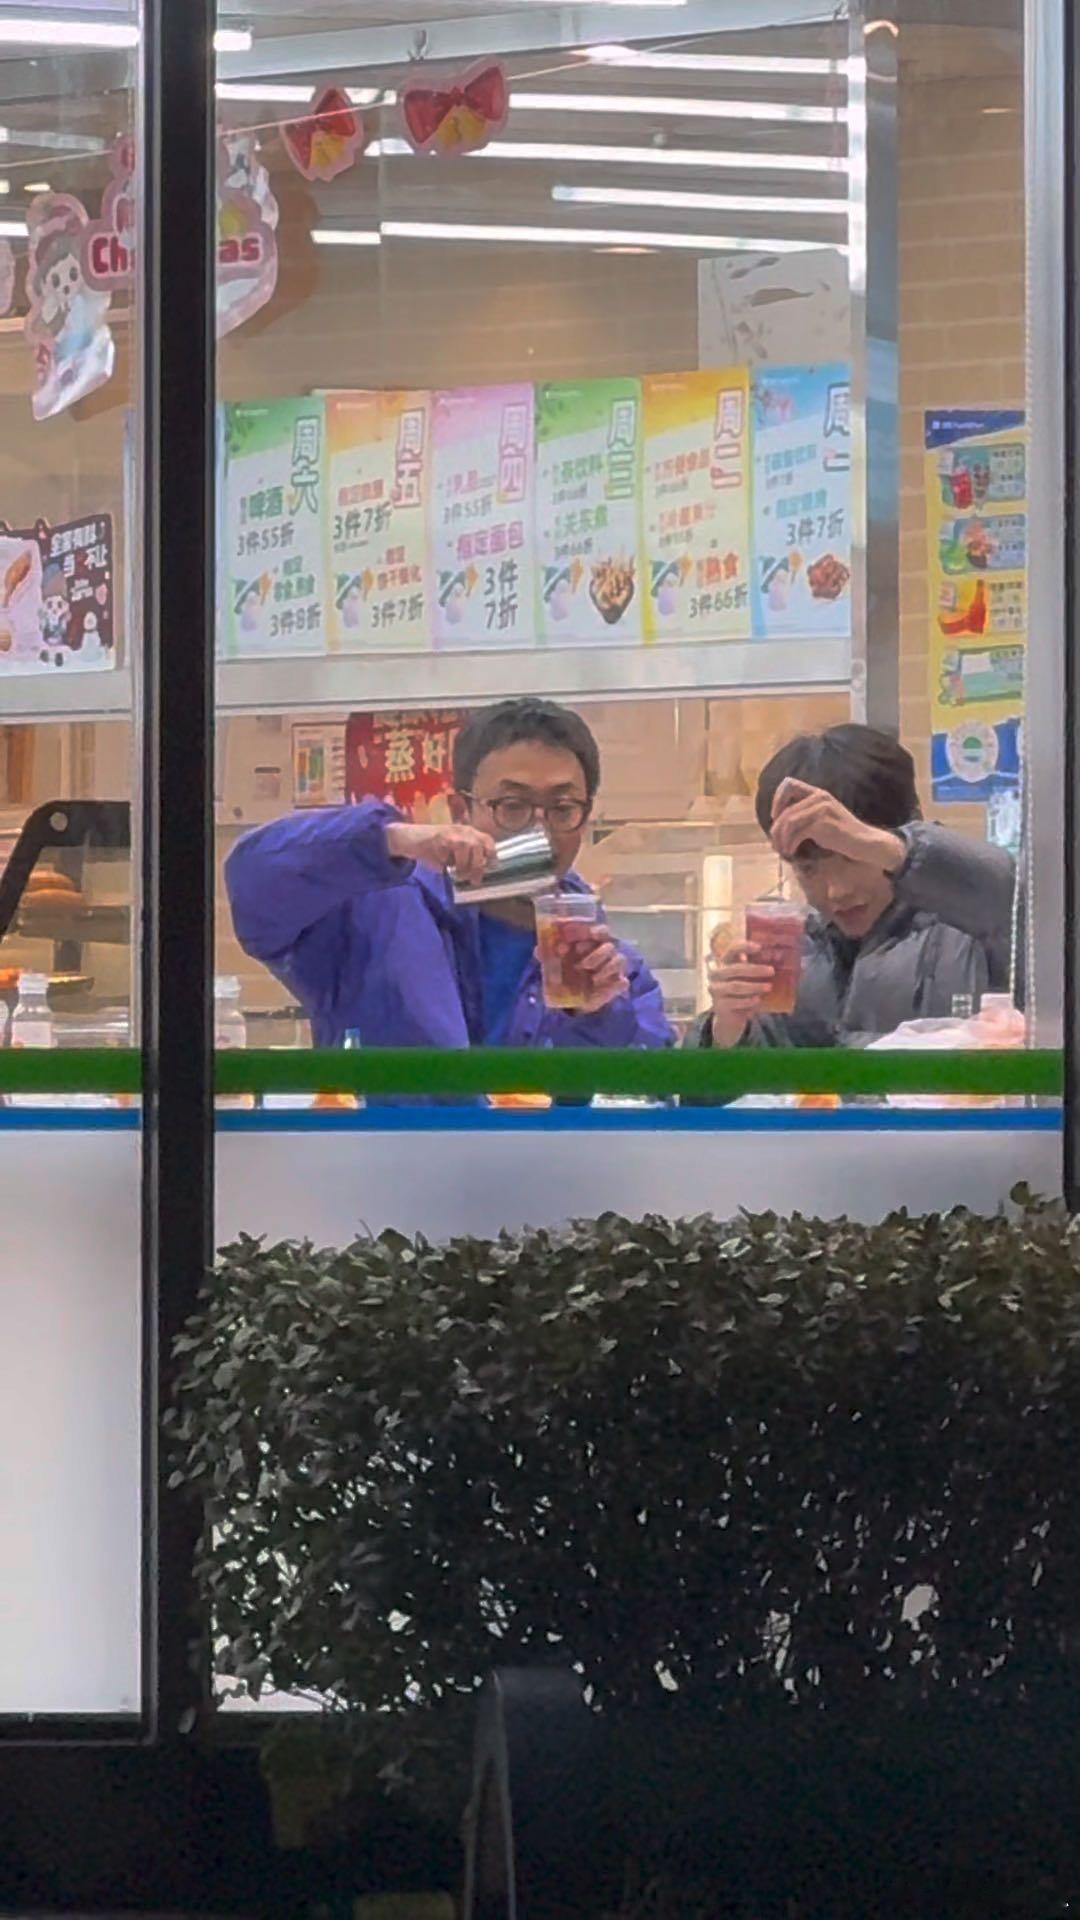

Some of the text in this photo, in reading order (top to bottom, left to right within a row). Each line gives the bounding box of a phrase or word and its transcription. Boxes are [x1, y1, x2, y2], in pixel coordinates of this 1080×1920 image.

[391, 407, 426, 509] 周五
[497, 402, 528, 503] 周四
[606, 397, 637, 502] 周三
[711, 387, 746, 490] 周二
[288, 415, 321, 516] 周六
[236, 521, 295, 557] 3件55折
[332, 502, 393, 541] 3件7折
[785, 508, 845, 546] 3件7折
[483, 557, 519, 596] 3件
[269, 602, 322, 638] 3件8折
[370, 592, 424, 629] 3件7折
[485, 593, 519, 631] 7折
